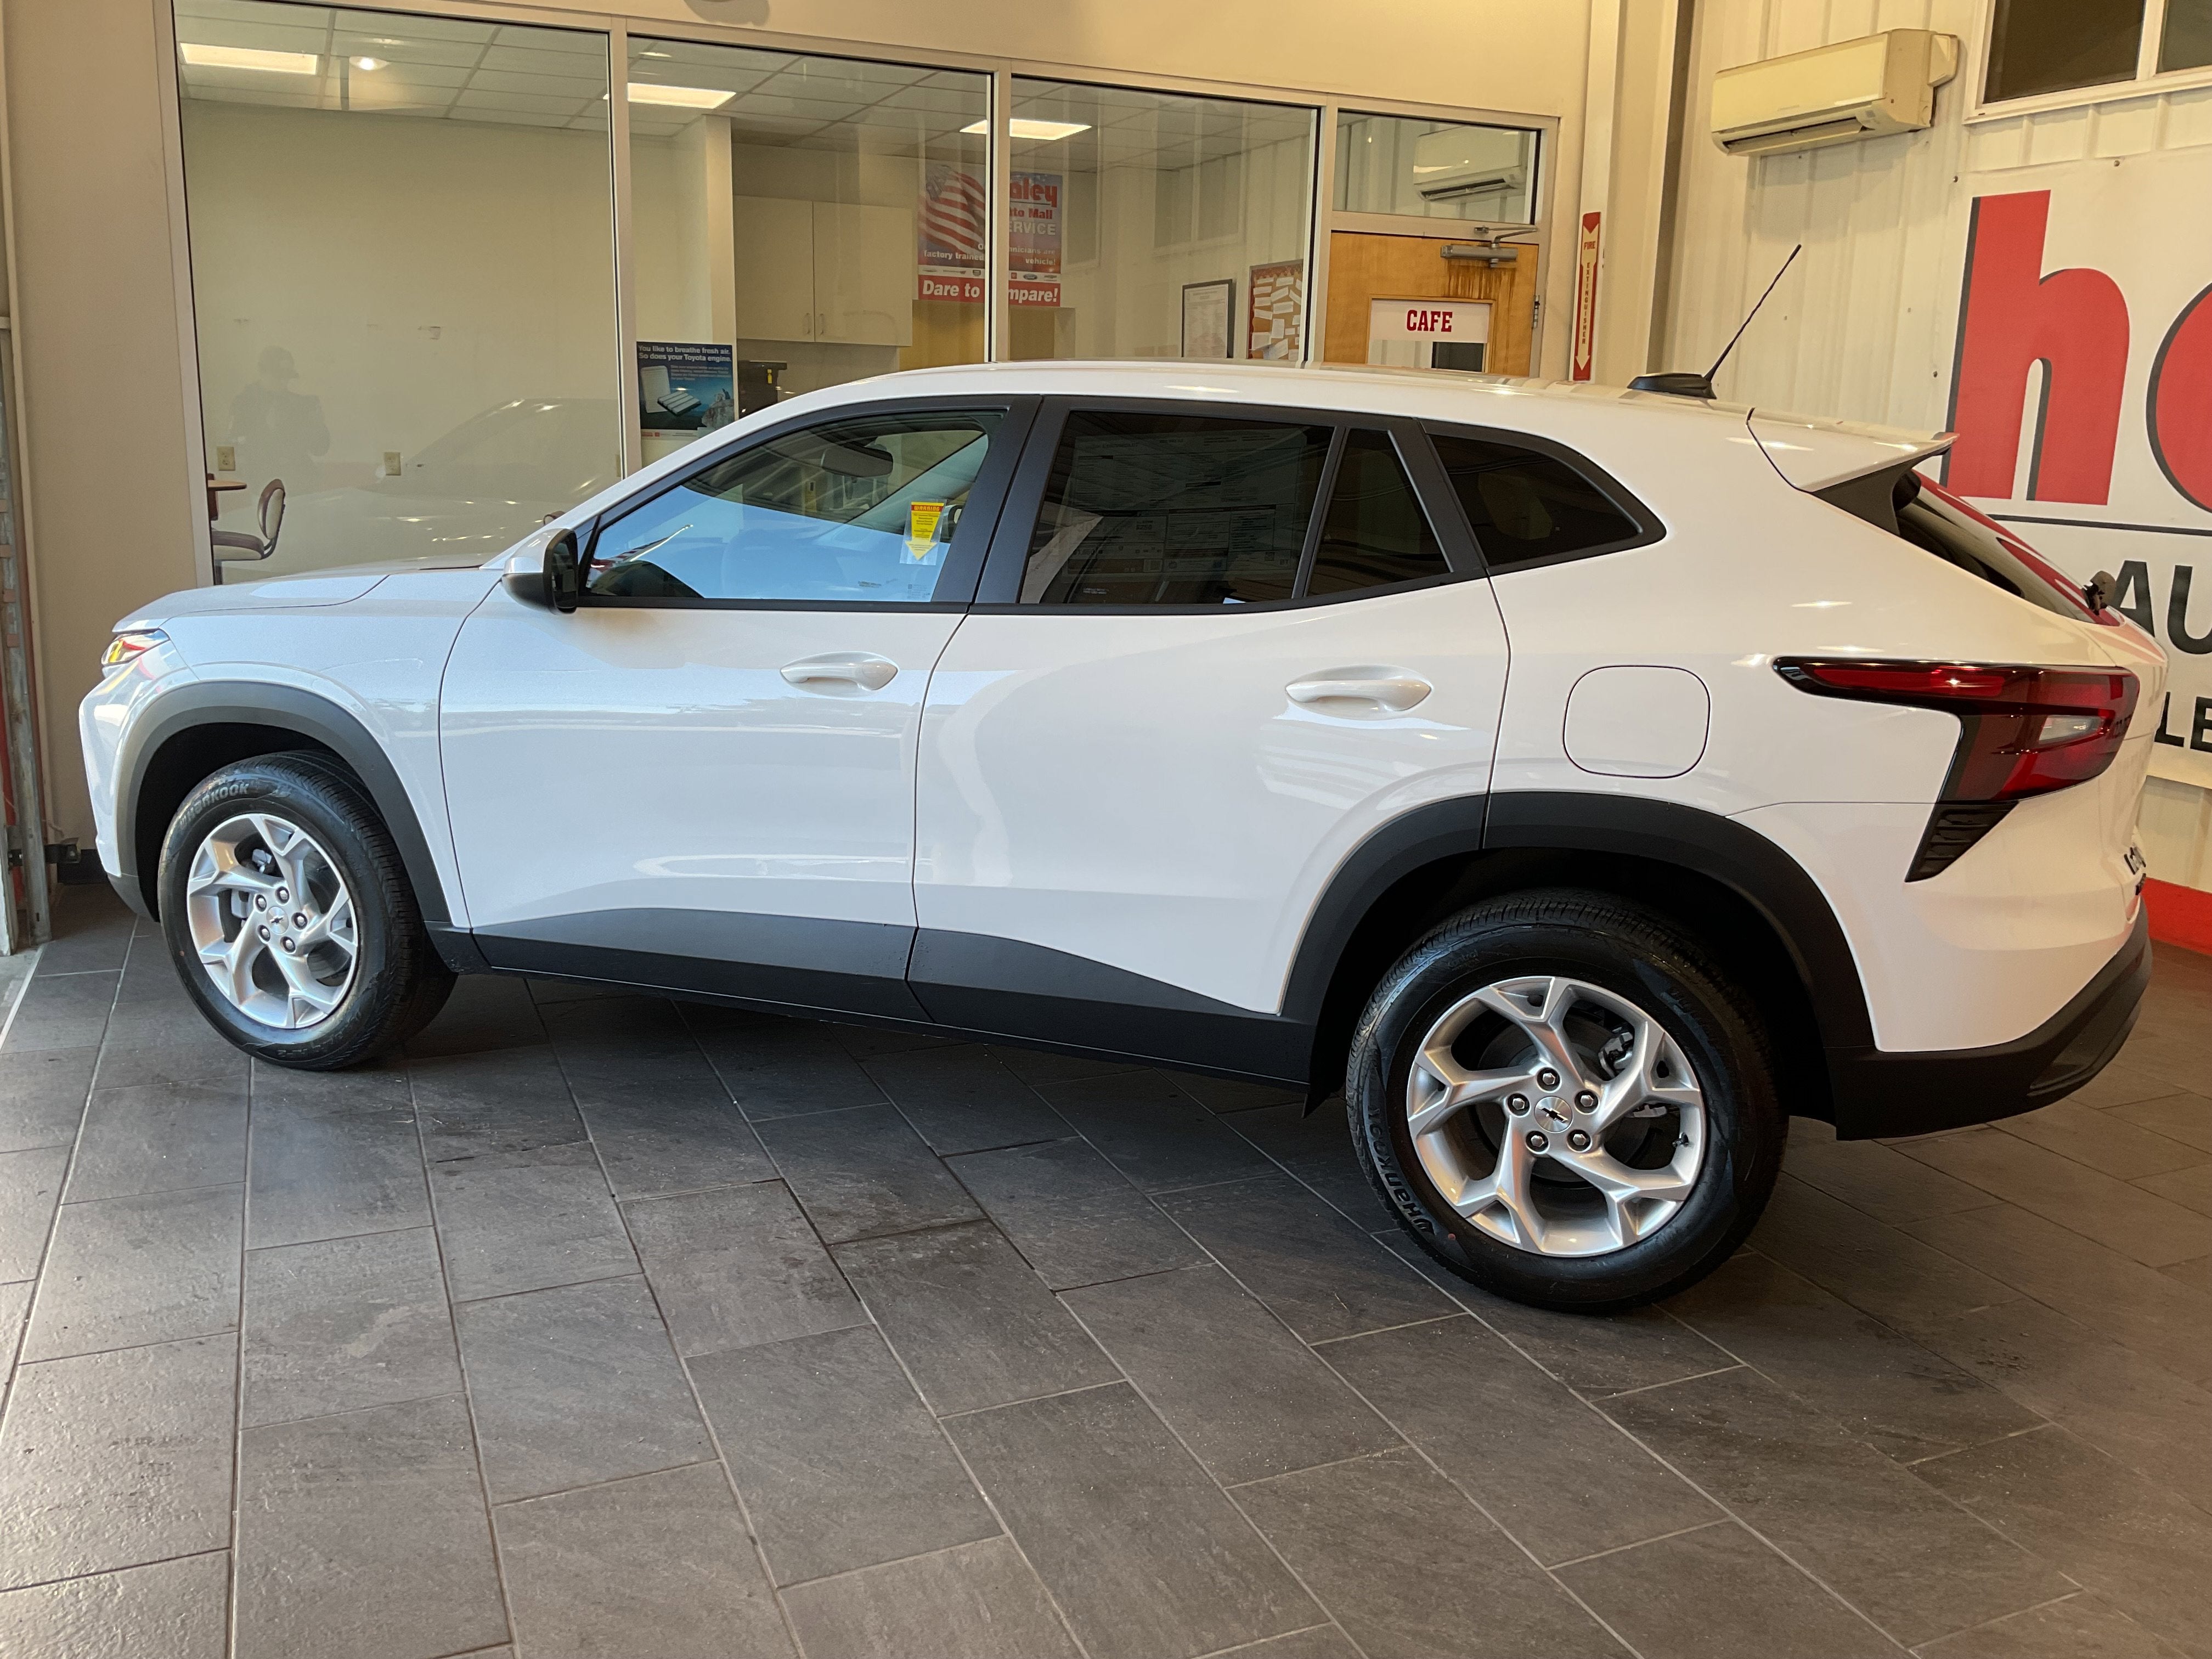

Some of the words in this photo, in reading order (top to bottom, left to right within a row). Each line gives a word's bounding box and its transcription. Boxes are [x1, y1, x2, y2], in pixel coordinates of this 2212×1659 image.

[1009, 177, 1057, 208] aley
[1009, 208, 1025, 217] to
[1029, 208, 1053, 219] Mall
[1009, 221, 1056, 235] RVICE
[1009, 246, 1041, 254] nicians
[1583, 241, 1596, 251] FIRE
[924, 250, 953, 260] factory
[955, 252, 985, 261] trained
[922, 280, 960, 296] Dare
[964, 283, 980, 298] to
[1008, 288, 1058, 303] mpare!
[1582, 262, 1590, 344] EXTINGUISHER
[1406, 309, 1453, 332] CAFE
